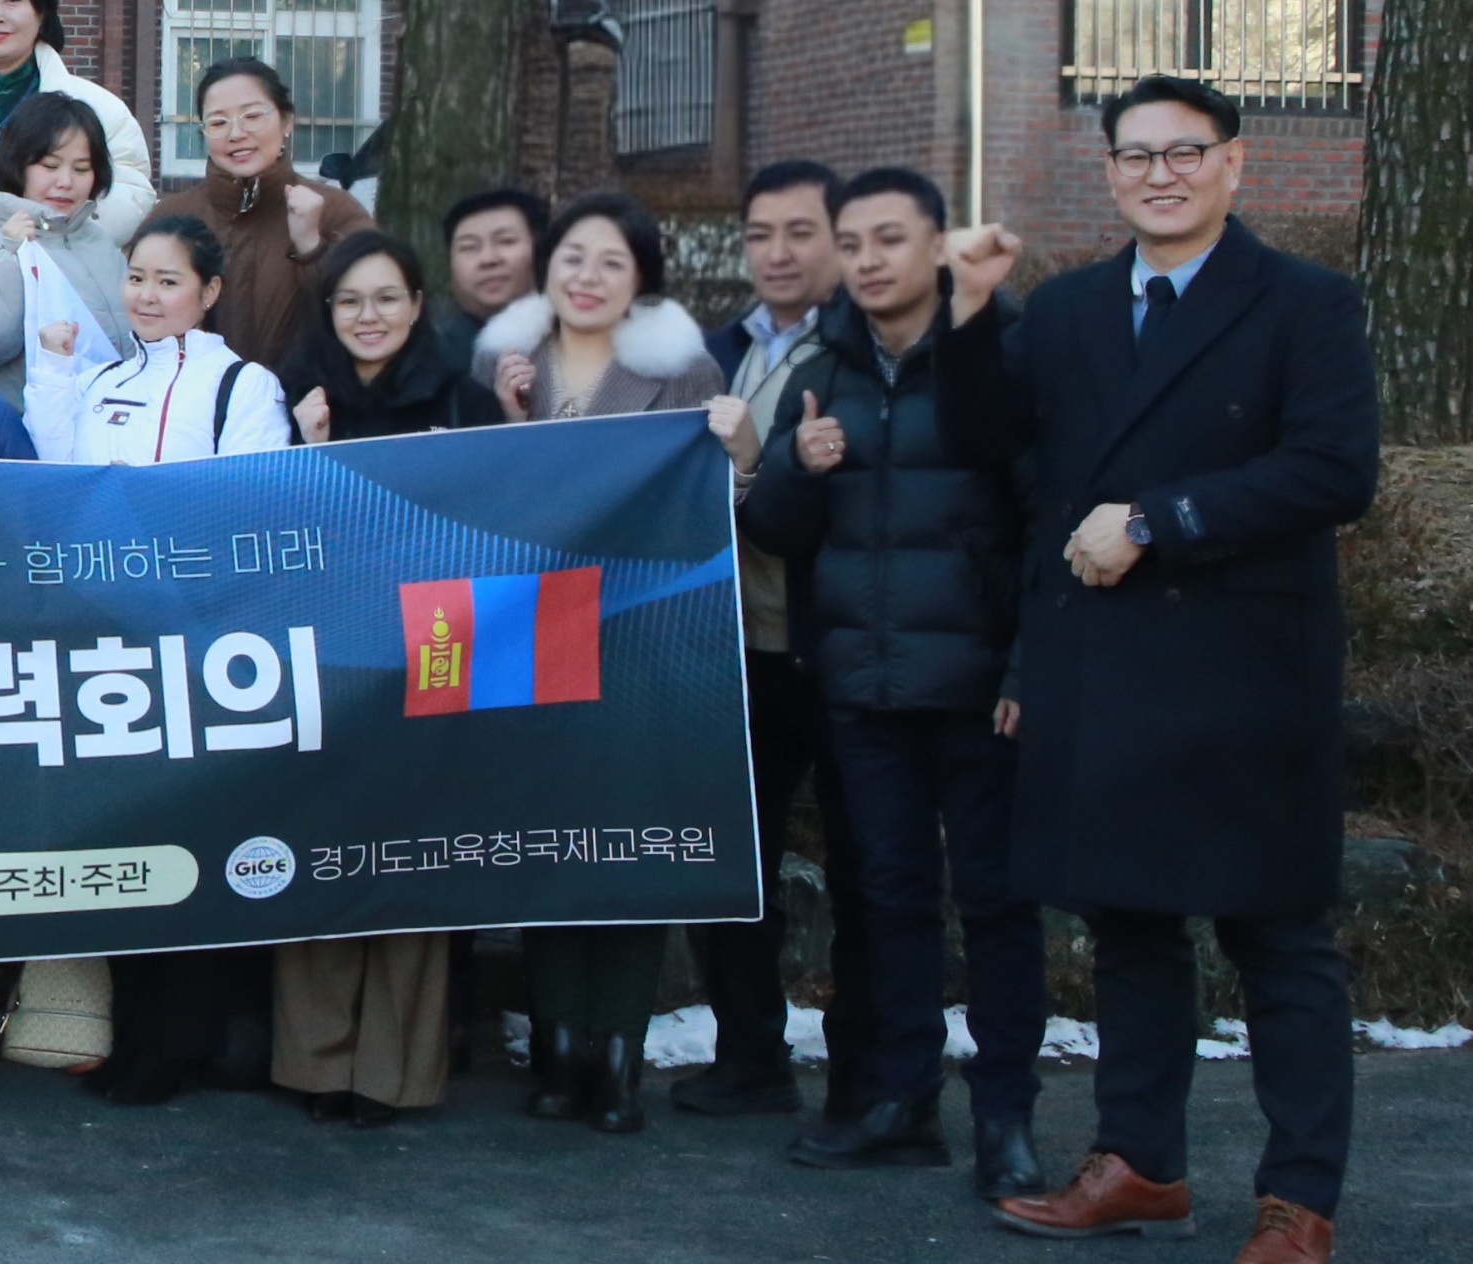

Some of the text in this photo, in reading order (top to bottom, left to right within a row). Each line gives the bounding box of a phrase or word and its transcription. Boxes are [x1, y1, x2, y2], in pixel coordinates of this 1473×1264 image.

[23, 536, 213, 585] 함께하는
[232, 526, 324, 575] 미래
[310, 826, 716, 881] 경기도교육청국제교육원
